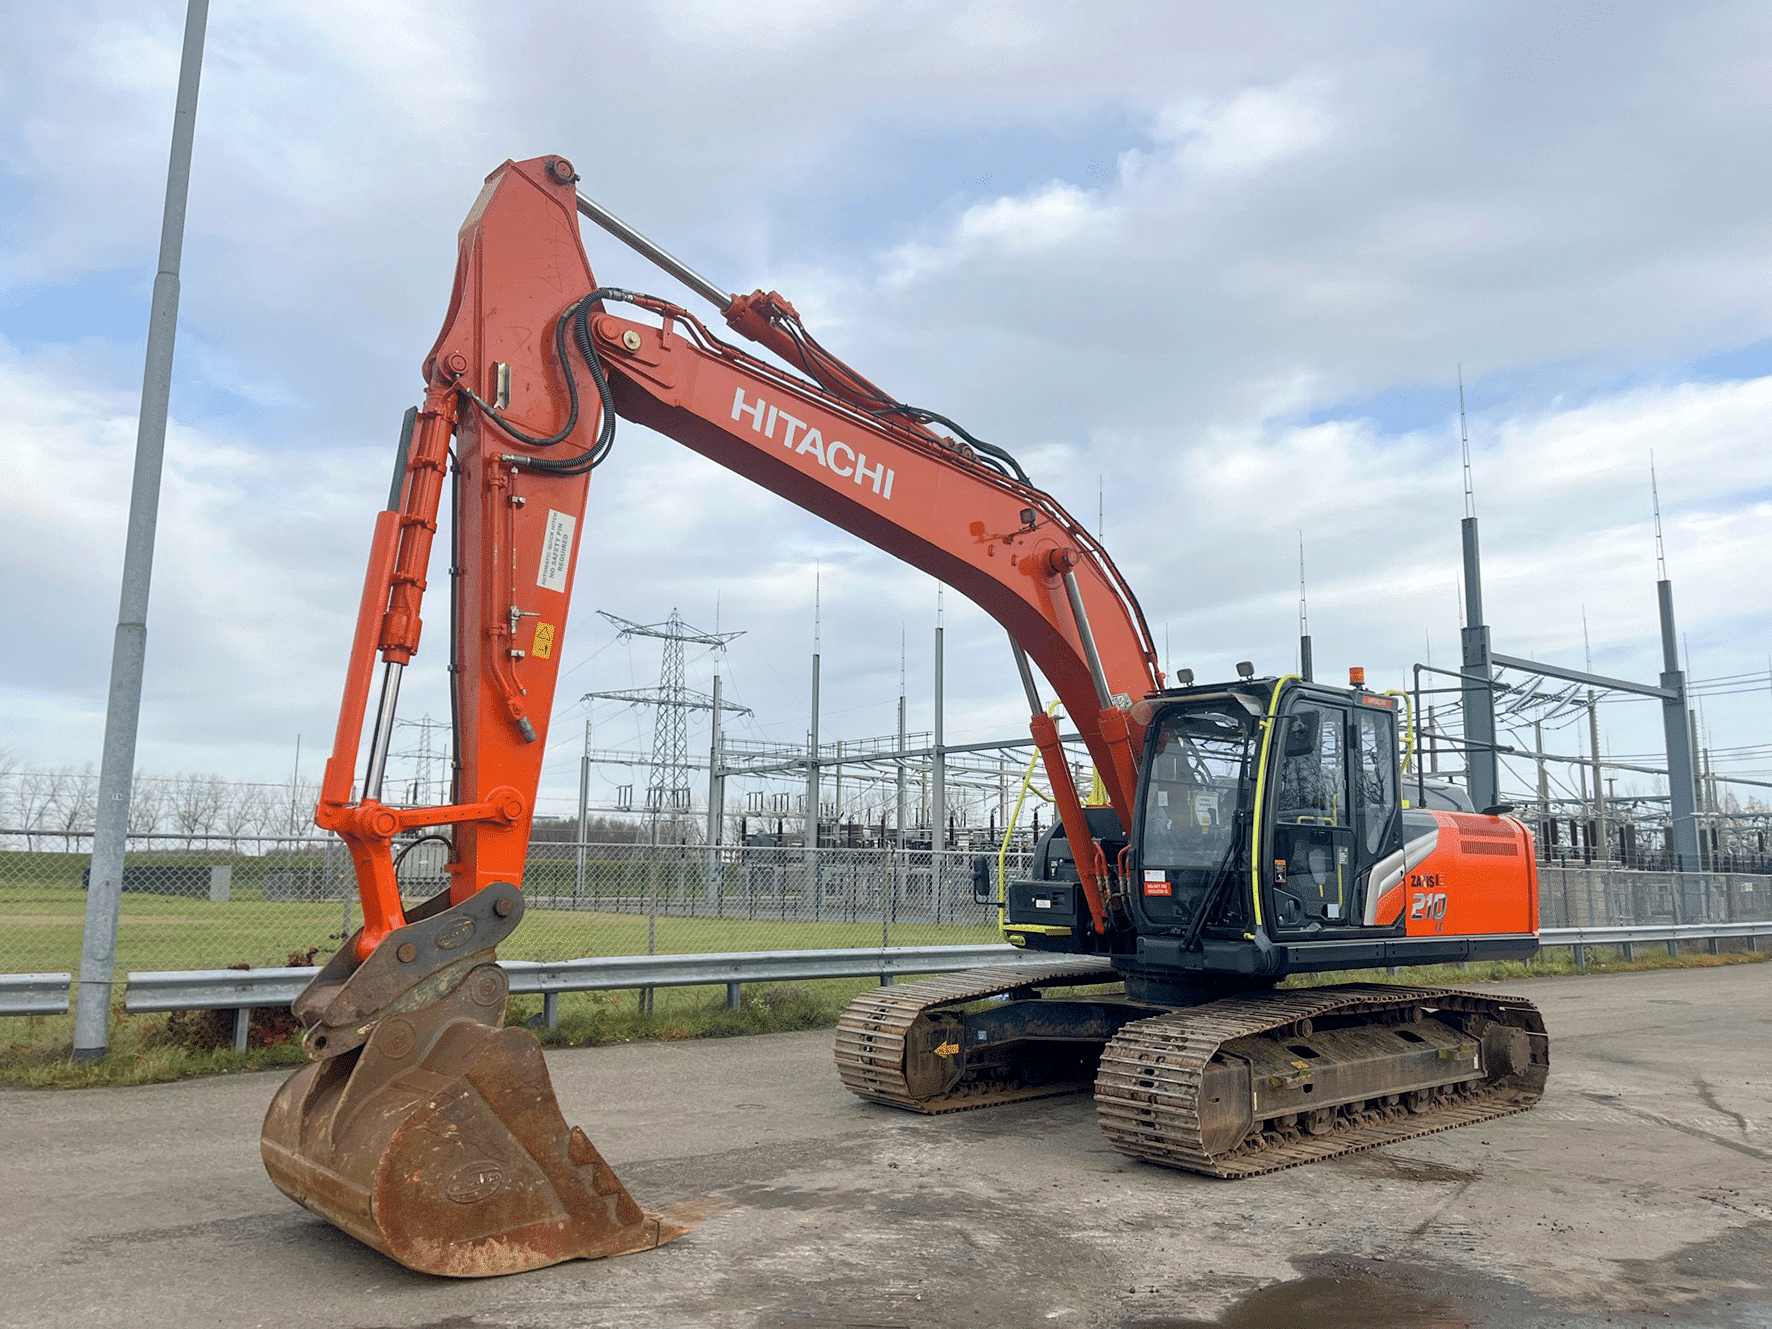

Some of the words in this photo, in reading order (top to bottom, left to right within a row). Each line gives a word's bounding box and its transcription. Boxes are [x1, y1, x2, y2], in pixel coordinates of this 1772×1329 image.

[731, 387, 895, 500] HITACHI
[556, 522, 564, 536] PIN
[541, 551, 552, 586] AUTOMATIC
[547, 531, 555, 551] QUICK
[552, 537, 561, 566] SAFETY
[557, 534, 569, 572] REQUIRED
[549, 567, 556, 579] NO
[1410, 893, 1447, 920] 210
